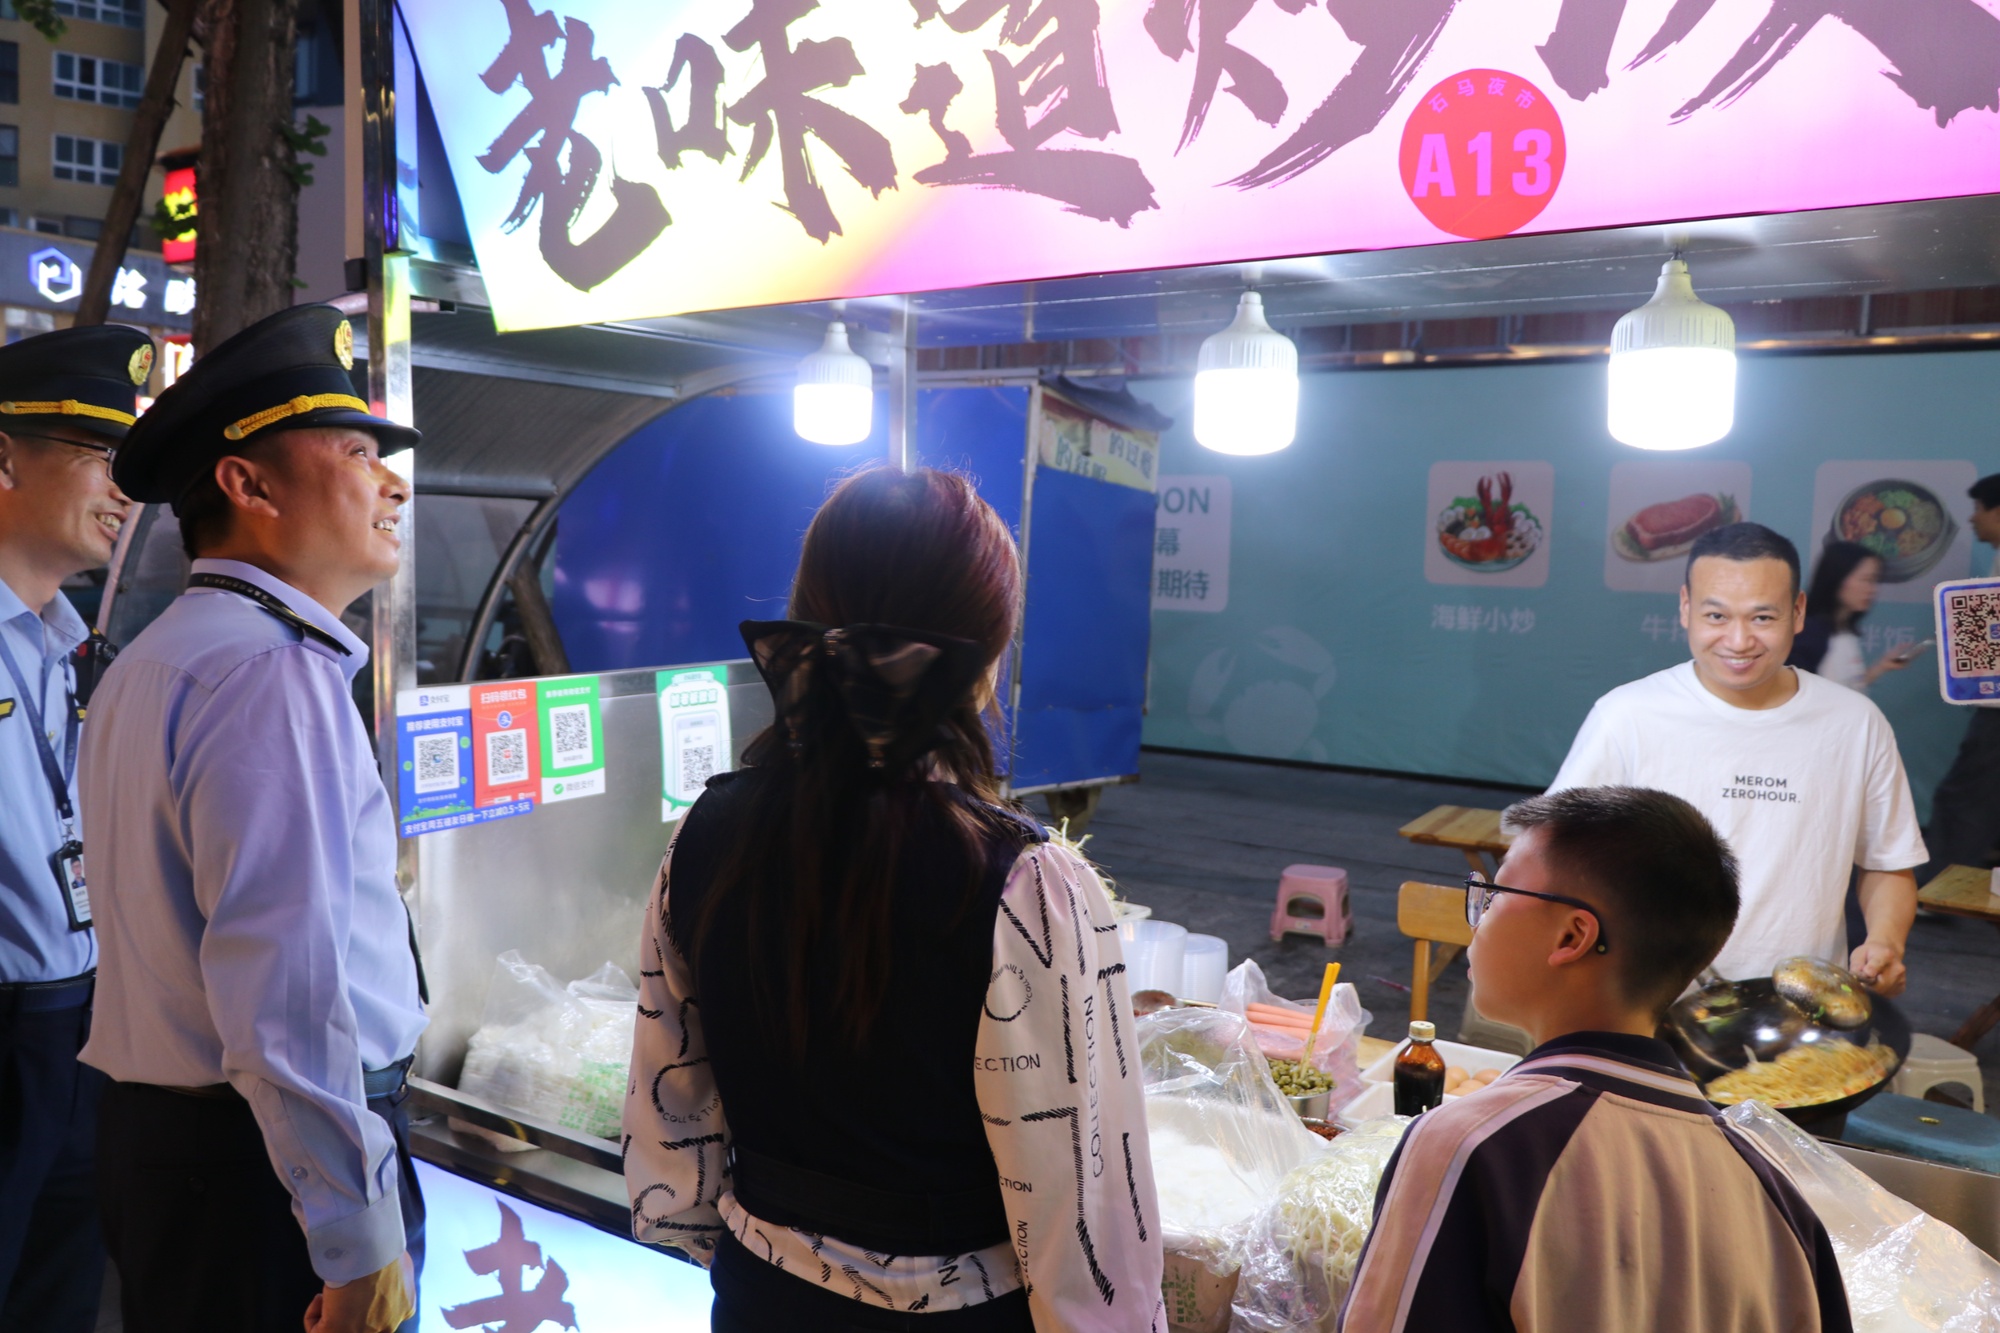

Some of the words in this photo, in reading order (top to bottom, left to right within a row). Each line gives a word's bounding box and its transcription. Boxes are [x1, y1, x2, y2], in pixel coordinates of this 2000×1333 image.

[1428, 77, 1536, 113] 石马夜市
[1412, 128, 1553, 198] A13
[1156, 487, 1210, 514] ON
[1431, 603, 1536, 633] 海鲜小炒
[1734, 775, 1788, 788] MEROM
